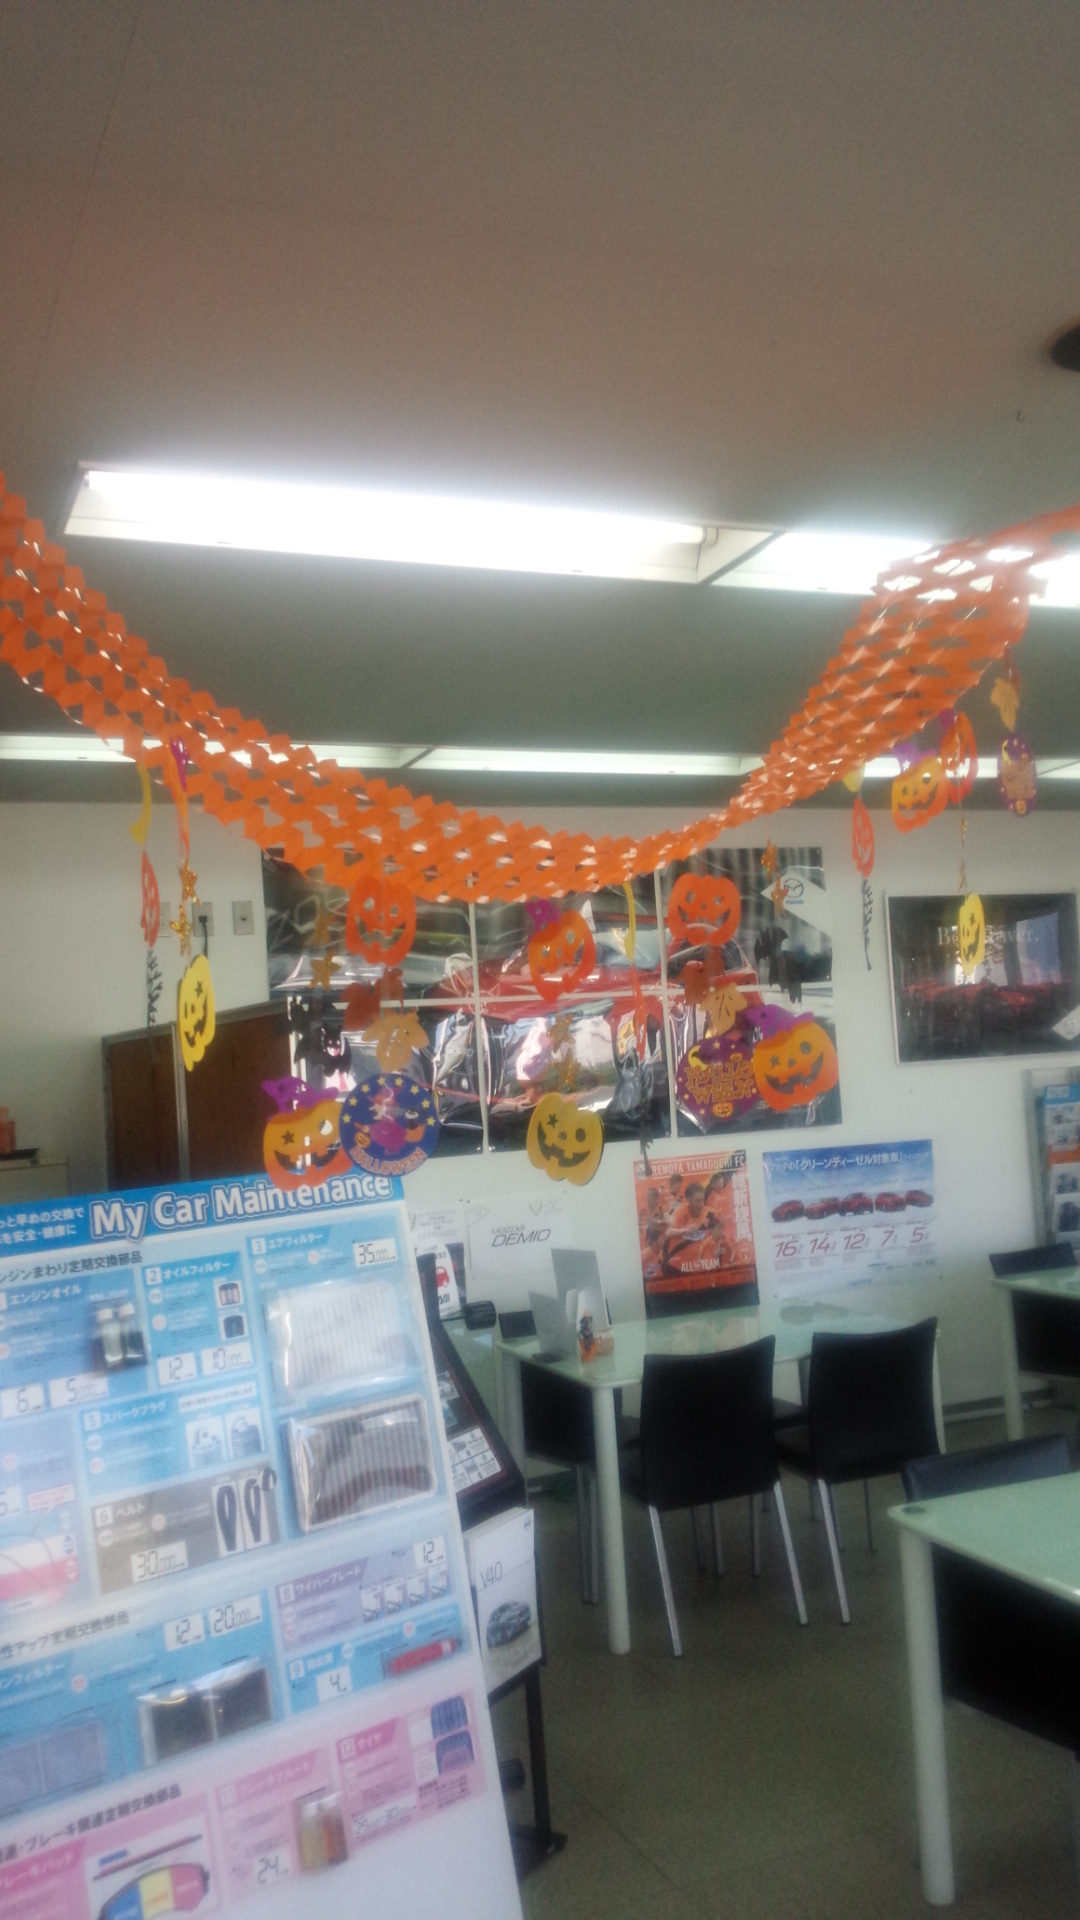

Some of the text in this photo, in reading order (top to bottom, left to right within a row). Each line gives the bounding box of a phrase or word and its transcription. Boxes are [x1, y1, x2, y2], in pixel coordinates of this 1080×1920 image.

[349, 1146, 428, 1176] HALLOWEEN
[686, 1158, 733, 1172] YAMAGUCHI
[91, 1175, 391, 1240] My Car Maintenance
[491, 1229, 551, 1247] DEMIO
[843, 1233, 866, 1251] 12
[881, 1229, 895, 1247] 7
[910, 1227, 926, 1243] 5
[810, 1236, 830, 1254] 14
[480, 1561, 503, 1588] V40
